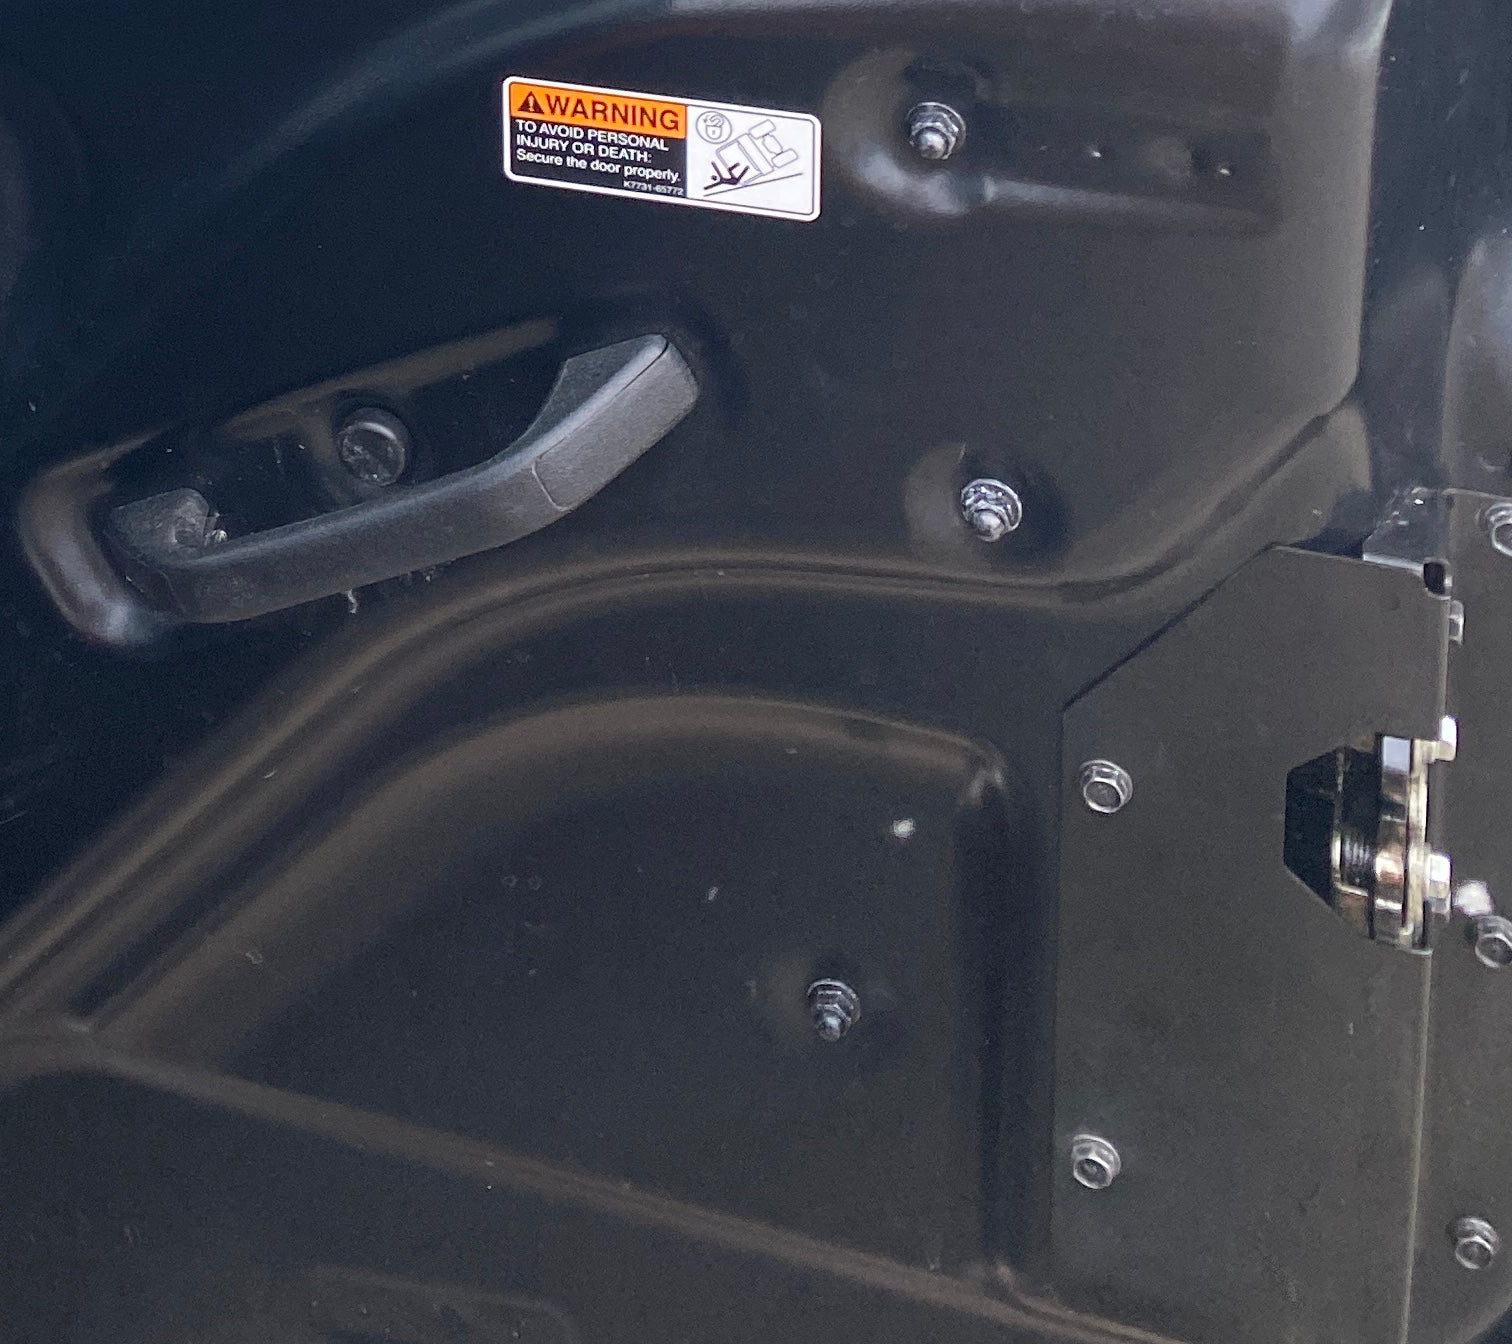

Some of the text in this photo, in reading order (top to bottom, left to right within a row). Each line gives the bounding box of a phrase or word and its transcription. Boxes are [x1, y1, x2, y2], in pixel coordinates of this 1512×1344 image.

[545, 93, 679, 131] WARNING
[516, 120, 669, 151] TO AVOID PERSONAL
[517, 134, 652, 163] INJURY OR DEATH:
[516, 149, 681, 183] Secure the door properly.
